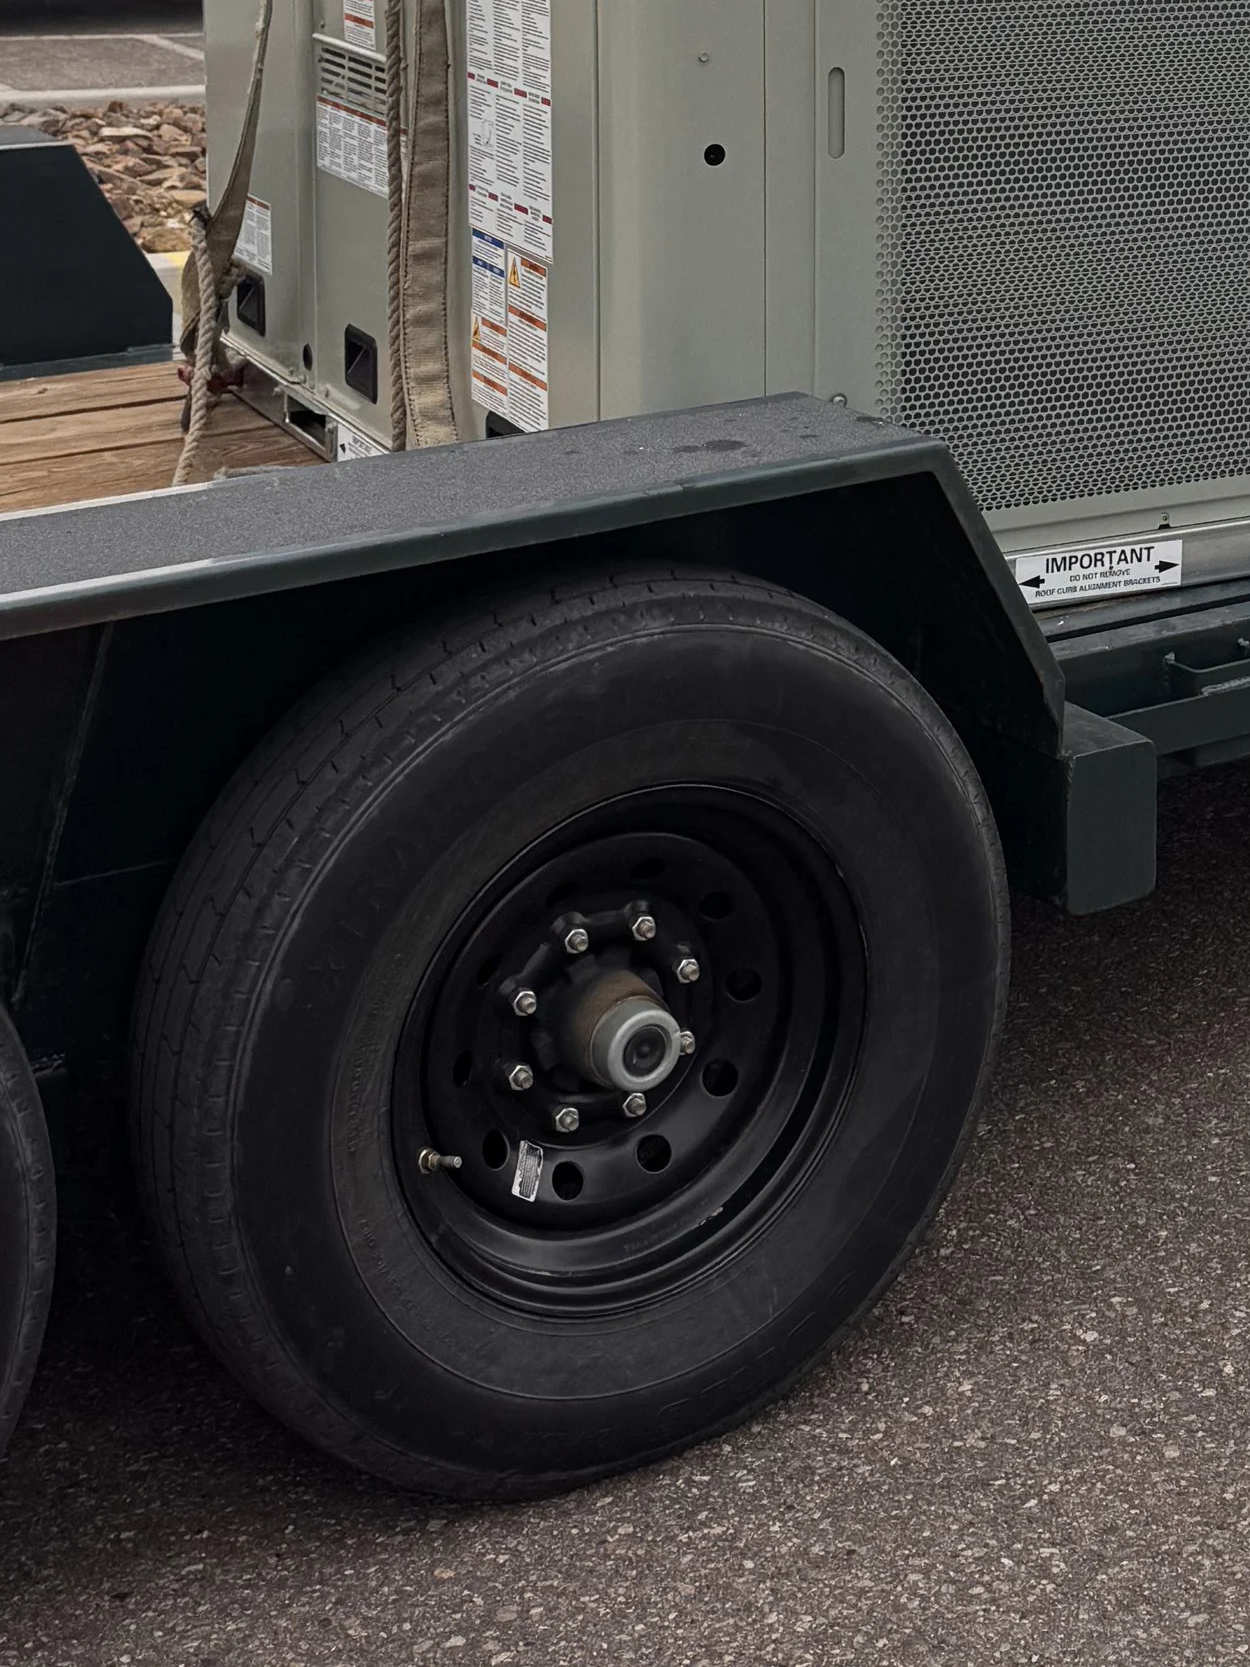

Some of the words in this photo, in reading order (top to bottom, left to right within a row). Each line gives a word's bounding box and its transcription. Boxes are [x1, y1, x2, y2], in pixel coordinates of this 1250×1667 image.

[1045, 546, 1155, 574] IMPORTANT
[1069, 573, 1081, 583] DO
[1082, 571, 1098, 581] NOT
[1099, 568, 1131, 579] REMOVE
[1035, 588, 1056, 598] ROOF
[1057, 585, 1078, 595] CURB
[1078, 580, 1122, 593] ALIGNMENT
[1123, 576, 1161, 587] BRACKETS
